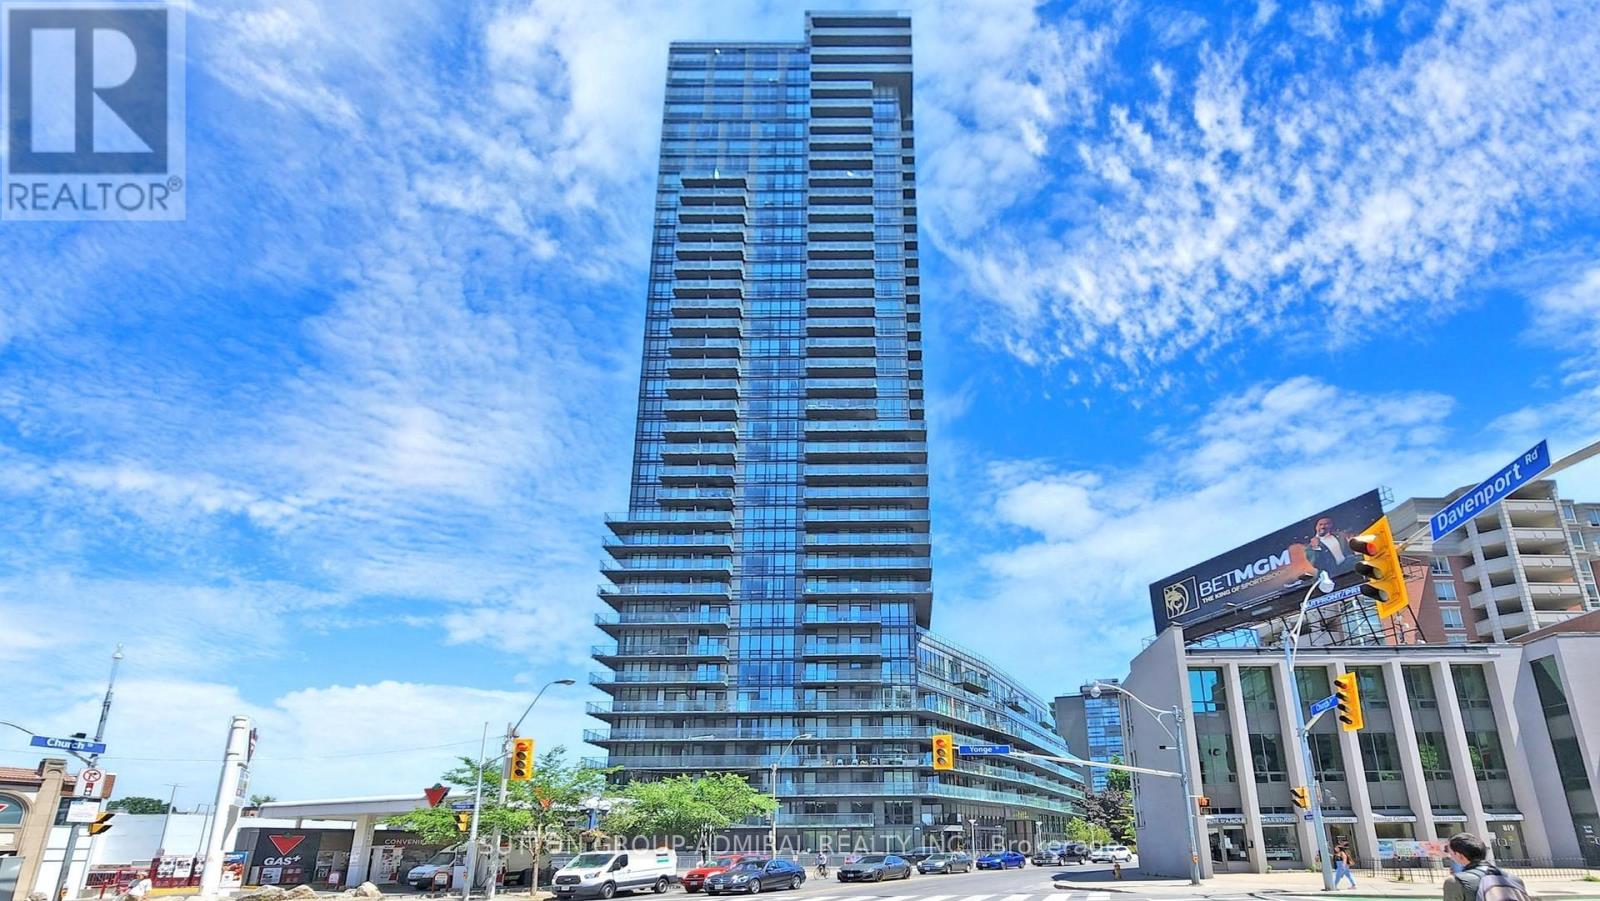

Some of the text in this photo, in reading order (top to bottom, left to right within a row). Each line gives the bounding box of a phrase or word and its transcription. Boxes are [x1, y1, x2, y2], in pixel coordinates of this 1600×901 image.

[1437, 449, 1539, 532] Davenport Rd
[1202, 596, 1215, 604] THE
[1214, 590, 1231, 600] KING
[1231, 585, 1241, 594] OF
[46, 738, 85, 750] Church
[969, 746, 992, 755] Yonge
[1502, 824, 1515, 832] 819
